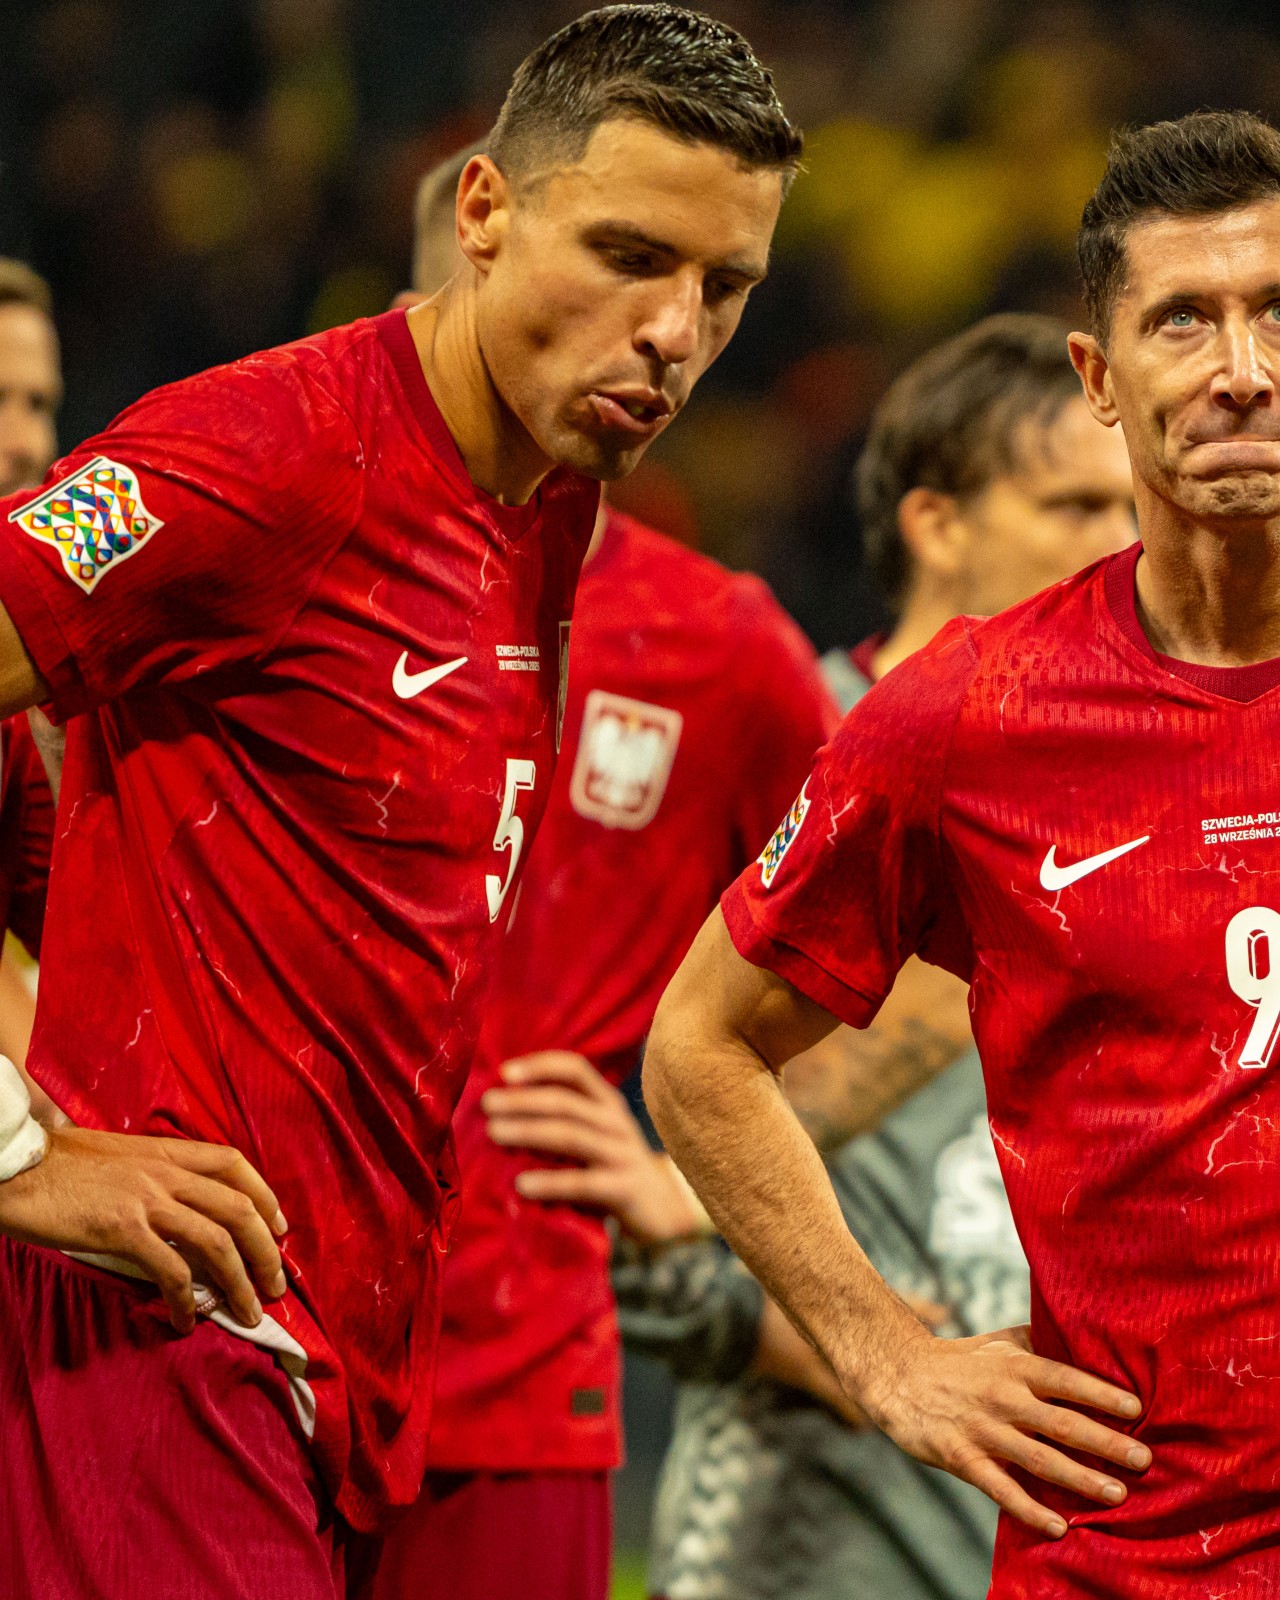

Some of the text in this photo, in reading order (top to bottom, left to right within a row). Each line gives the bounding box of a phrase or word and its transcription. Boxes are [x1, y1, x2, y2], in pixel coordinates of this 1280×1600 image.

[486, 758, 536, 923] 5
[1204, 833, 1218, 844] 28
[1219, 827, 1275, 842] WRZEŚNIA
